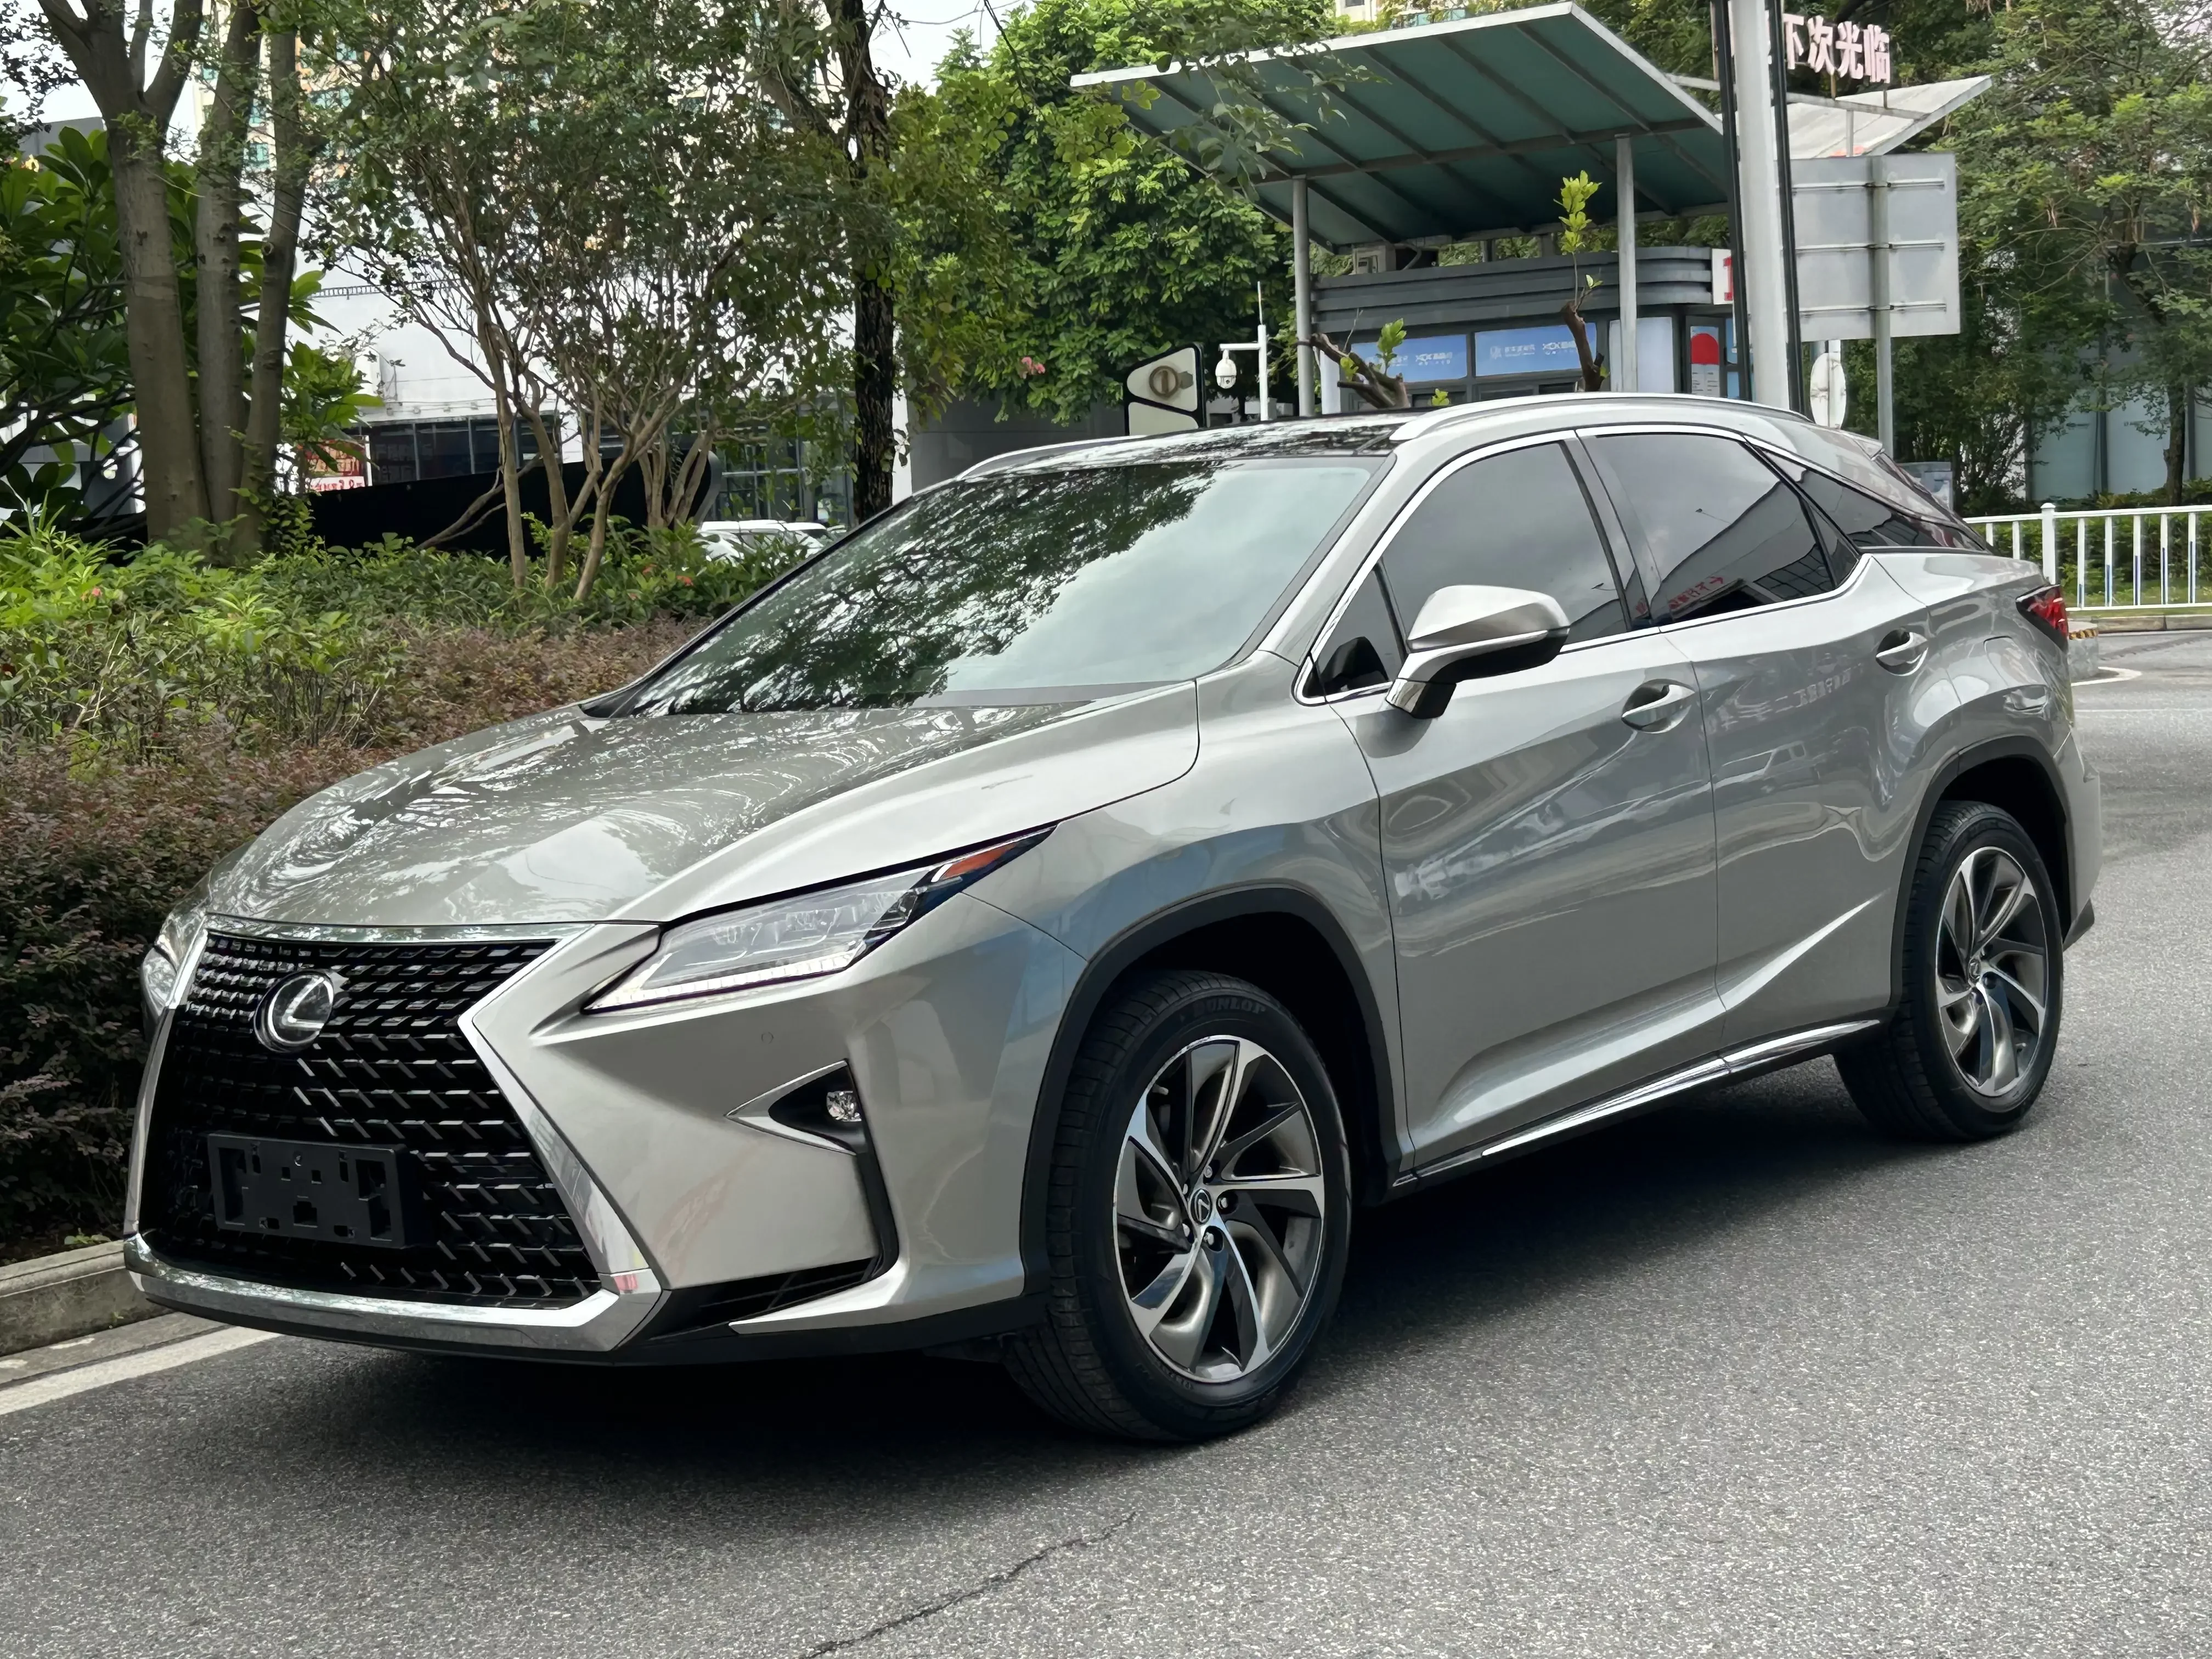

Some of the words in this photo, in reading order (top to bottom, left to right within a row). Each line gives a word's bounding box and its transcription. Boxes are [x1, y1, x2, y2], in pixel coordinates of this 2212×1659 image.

[1782, 14, 1891, 83] 下次光临
[1193, 997, 1266, 1018] DUNLOP
